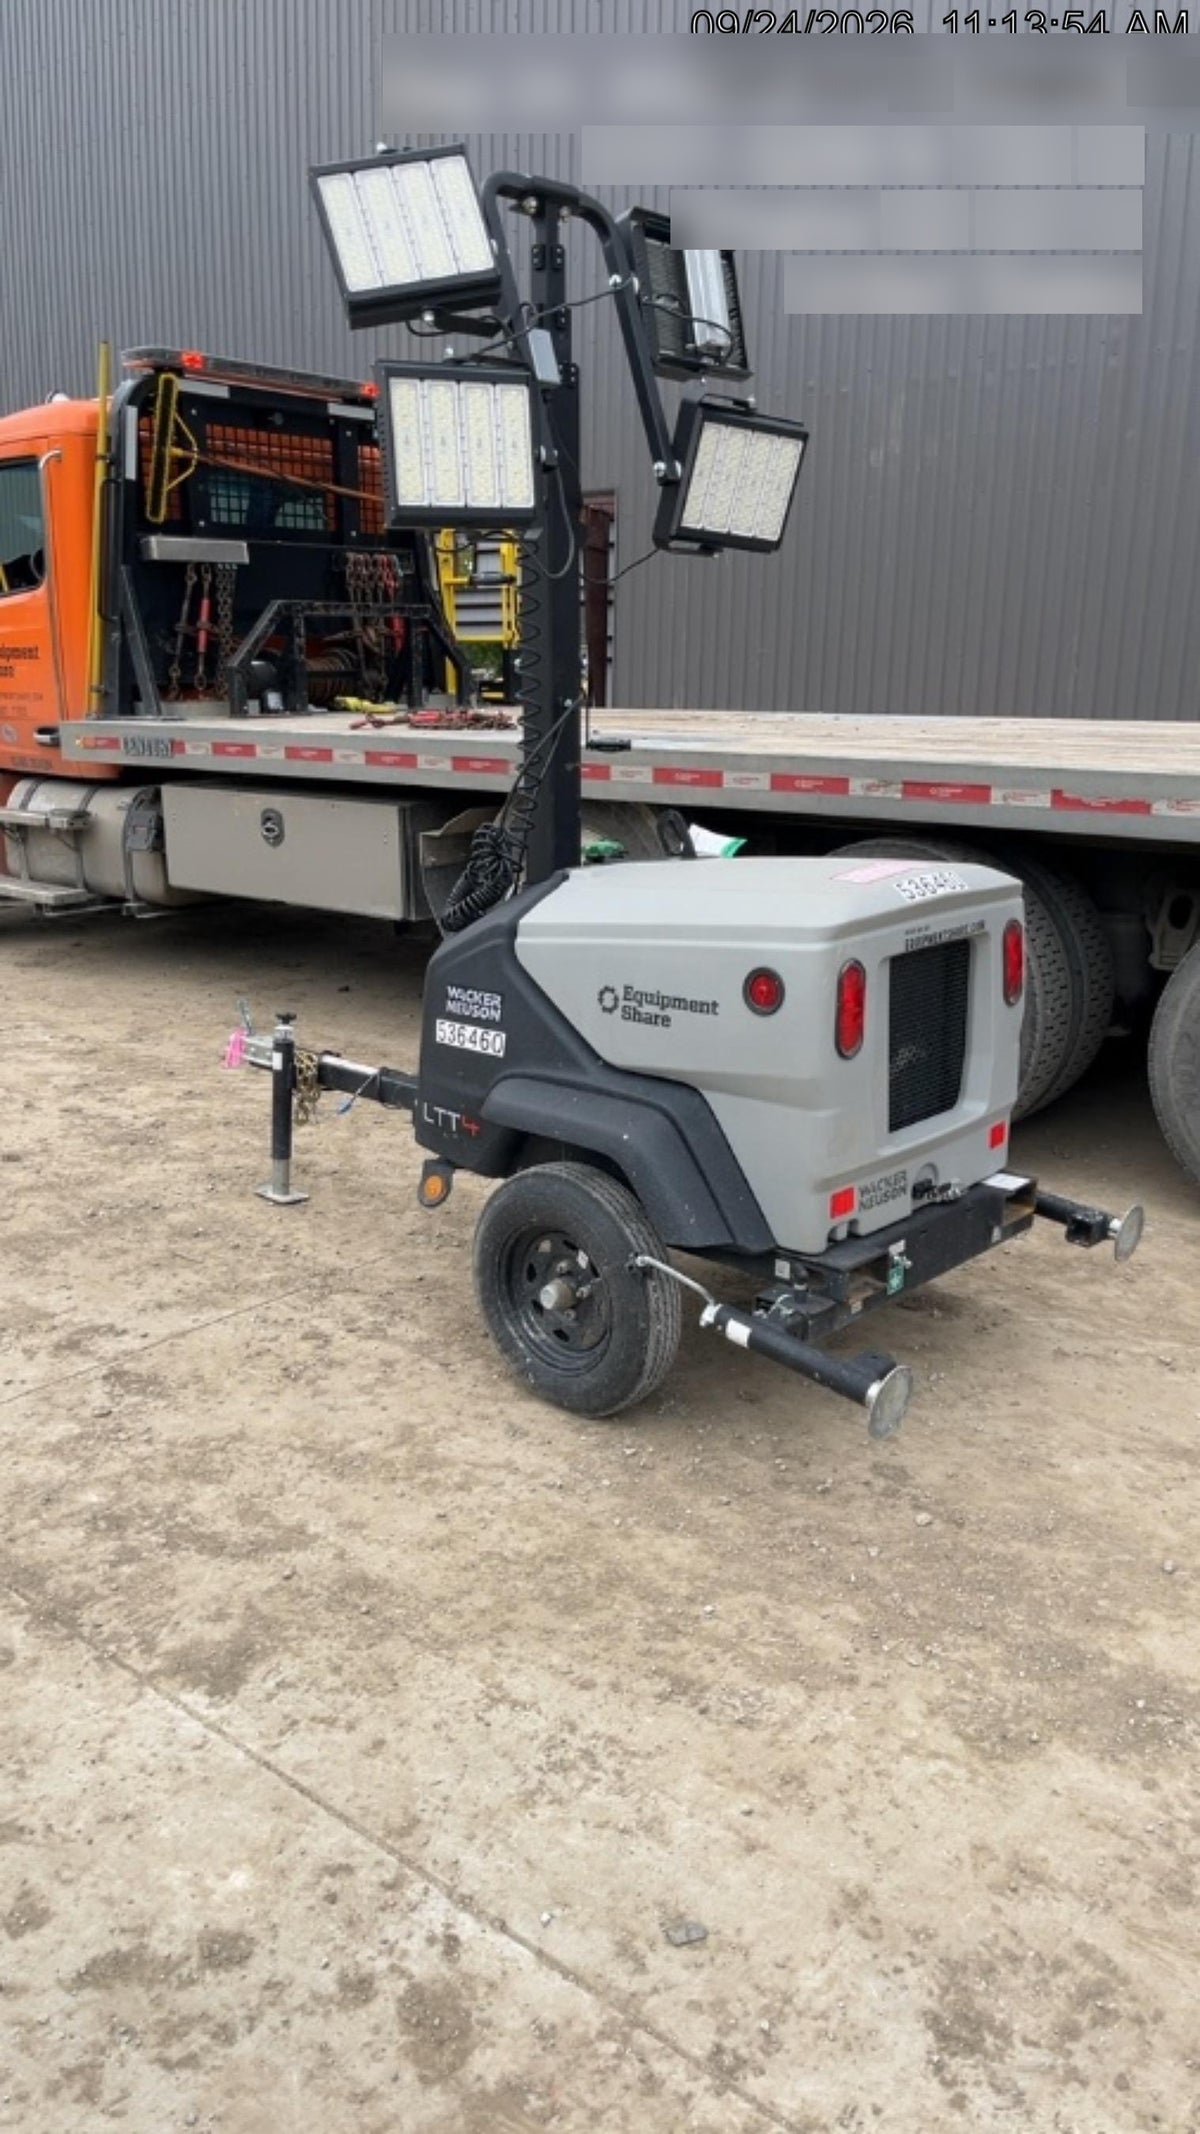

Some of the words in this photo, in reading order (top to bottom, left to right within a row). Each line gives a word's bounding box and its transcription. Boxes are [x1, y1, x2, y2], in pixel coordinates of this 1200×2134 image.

[446, 985, 502, 1008] WACKER
[622, 984, 719, 1016] Equipment
[445, 1000, 502, 1022] NEUSON
[621, 1004, 672, 1028] Share
[437, 1020, 504, 1055] 536460
[859, 1169, 907, 1196] WACKER
[859, 1185, 907, 1212] NEUSON
